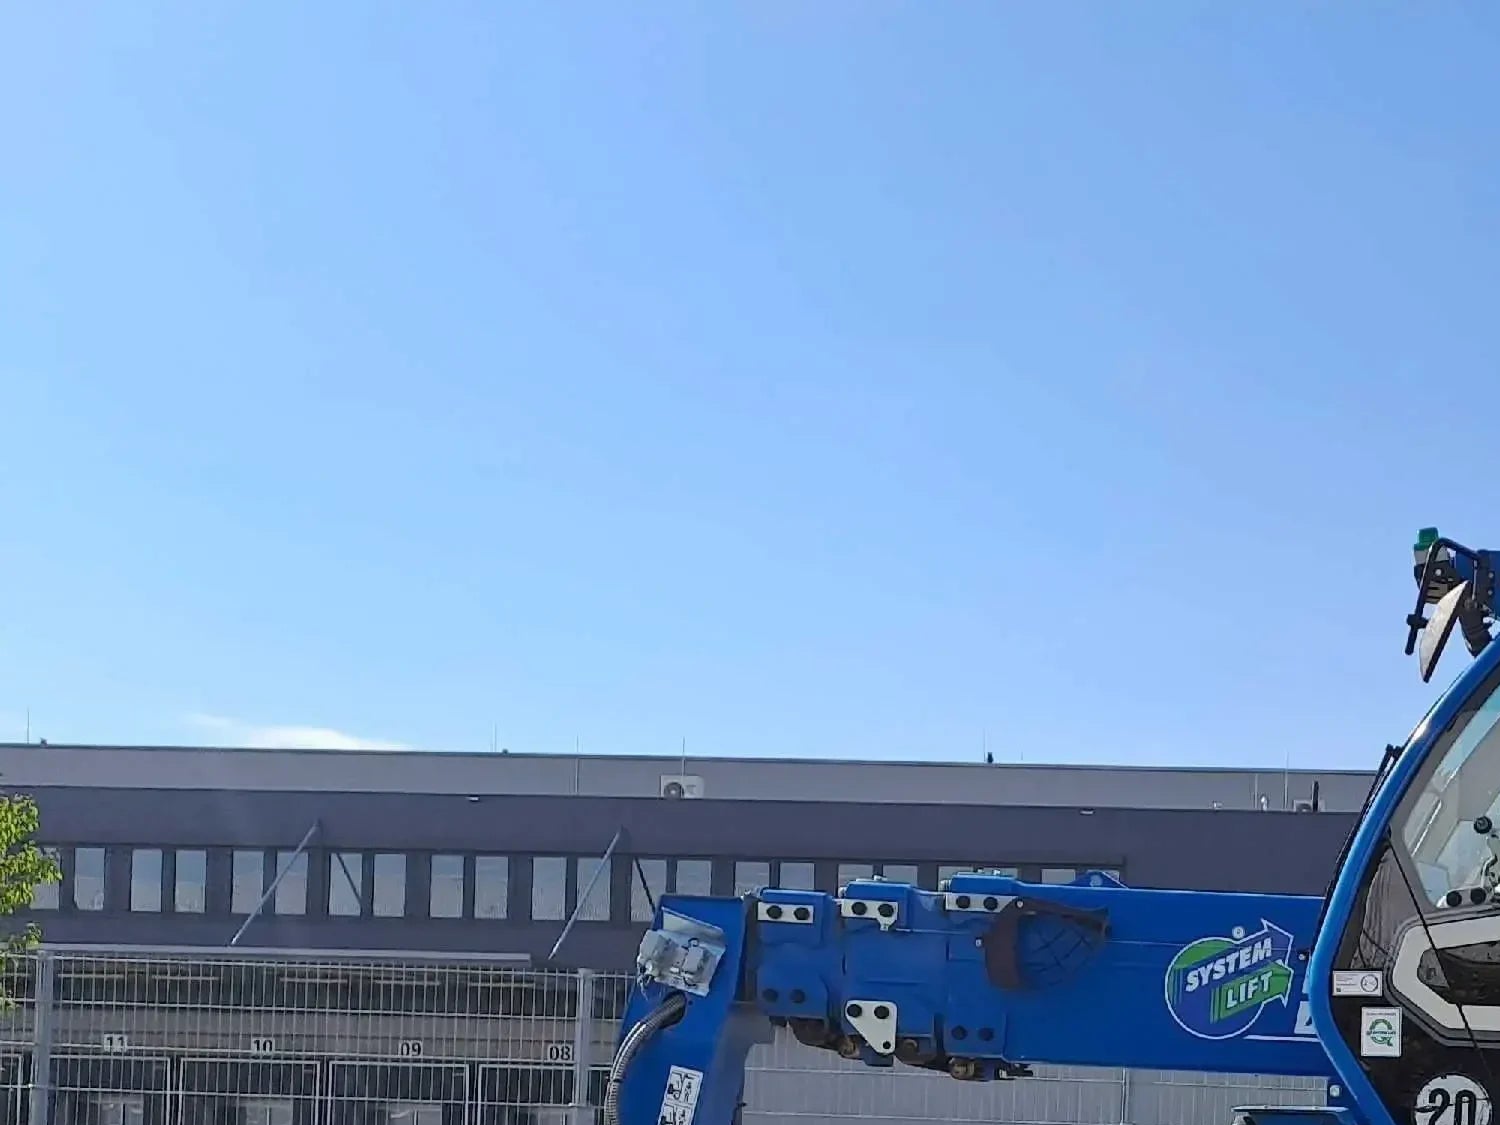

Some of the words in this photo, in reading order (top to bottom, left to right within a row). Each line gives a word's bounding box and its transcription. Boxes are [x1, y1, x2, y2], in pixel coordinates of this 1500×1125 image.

[1185, 937, 1273, 992] SYSTEM
[1226, 971, 1273, 1009] LIFT
[106, 1036, 126, 1049] 11
[253, 1039, 273, 1053] 10
[400, 1042, 422, 1056] 09
[549, 1045, 571, 1061] 08
